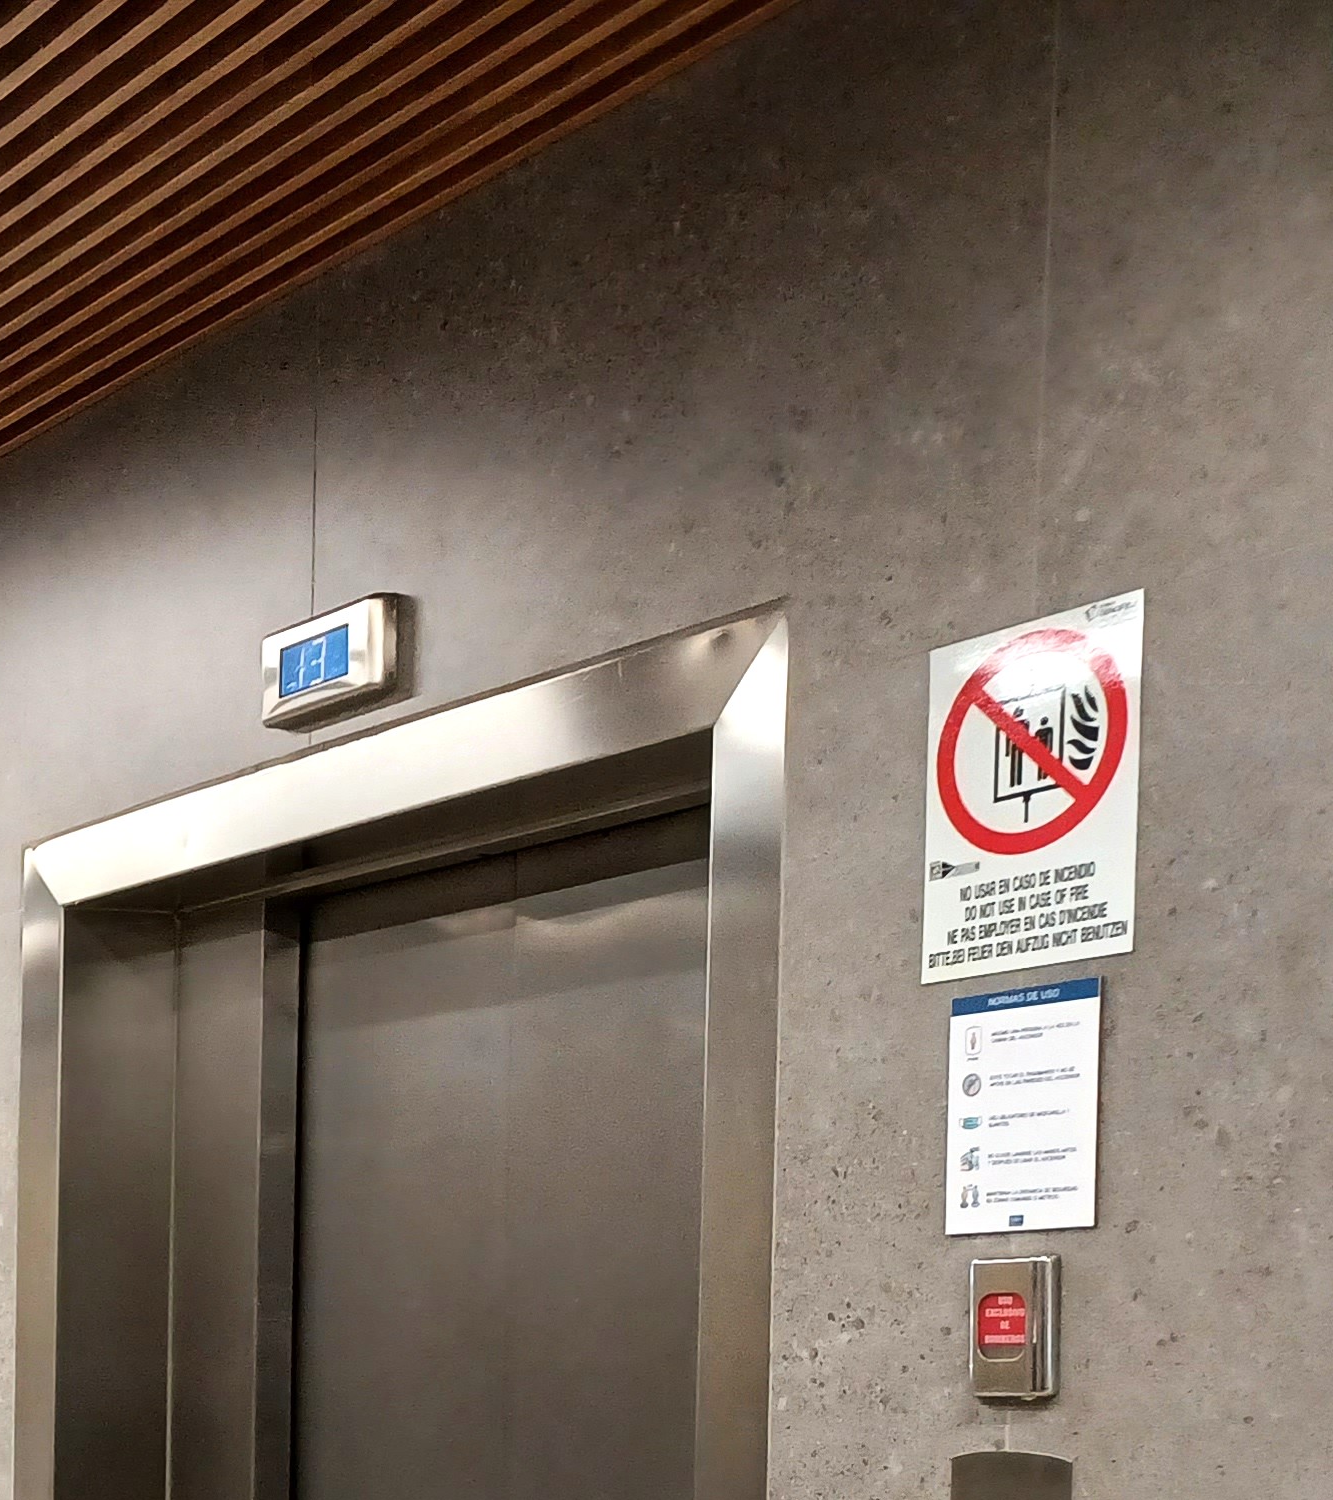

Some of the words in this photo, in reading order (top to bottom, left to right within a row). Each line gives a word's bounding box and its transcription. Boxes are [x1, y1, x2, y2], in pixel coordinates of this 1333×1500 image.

[960, 886, 971, 901] NO
[975, 881, 996, 900] USAR
[999, 878, 1010, 895] EN
[1013, 873, 1035, 891] CASO
[1039, 870, 1050, 887] DE
[1054, 861, 1095, 883] INCENDIO
[965, 906, 977, 921] DO
[979, 902, 995, 919] NOT
[999, 898, 1015, 915] USE
[1018, 896, 1026, 911] IN
[1029, 891, 1051, 909] CASE
[1054, 887, 1067, 904] OF
[1070, 884, 1089, 902] FIRE
[947, 929, 958, 945] NE
[960, 926, 976, 942] PAS
[979, 918, 1021, 939] EMPLOYER
[1024, 915, 1035, 931] EN
[1038, 912, 1056, 929] CAS
[968, 944, 992, 962] FEUER
[996, 941, 1012, 957] DEN
[1015, 934, 1049, 953] AUFZUG
[1052, 929, 1077, 947] NICHT
[1081, 920, 1128, 943] BENUTZEN
[1026, 990, 1039, 1002] DE
